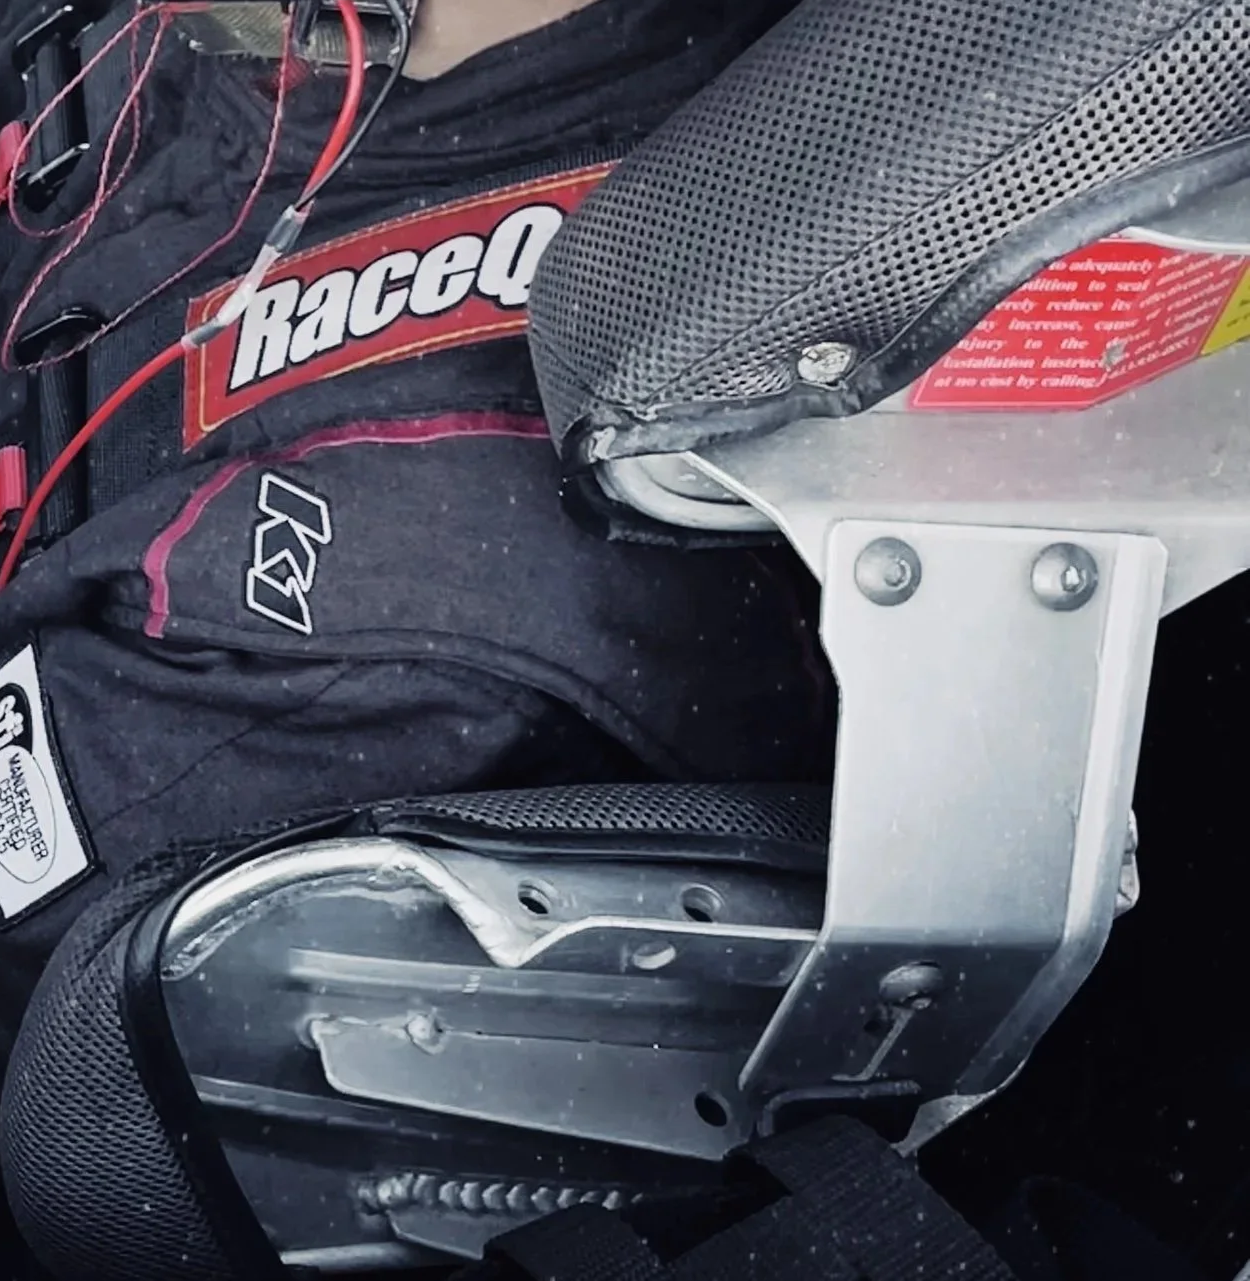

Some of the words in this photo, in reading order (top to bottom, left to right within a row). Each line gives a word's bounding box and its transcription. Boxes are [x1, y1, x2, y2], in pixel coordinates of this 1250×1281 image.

[227, 203, 567, 396] RaceQ
[957, 336, 1008, 352] njury
[1024, 337, 1043, 350] to
[1060, 337, 1090, 350] the
[995, 297, 1037, 314] erely
[1045, 298, 1104, 311] reduce
[246, 473, 333, 635] K1
[8, 752, 49, 862] MANUFACTURER
